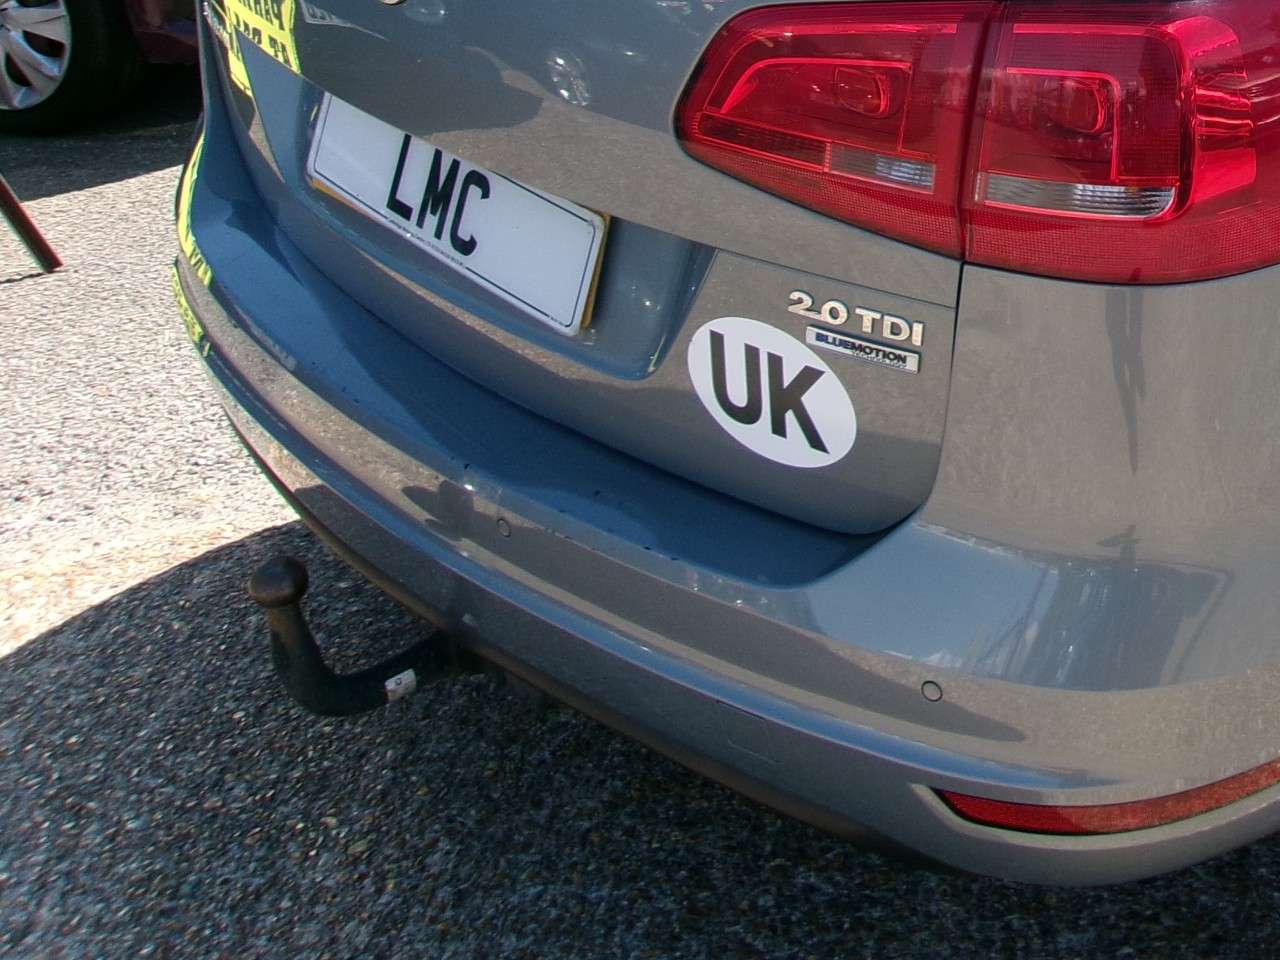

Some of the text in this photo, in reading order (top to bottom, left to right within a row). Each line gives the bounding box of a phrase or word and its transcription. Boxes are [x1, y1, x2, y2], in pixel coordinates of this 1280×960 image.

[386, 133, 491, 257] LMC
[815, 332, 907, 364] BLUEMOTION
[855, 305, 924, 347] TDI
[709, 329, 830, 455] UK
